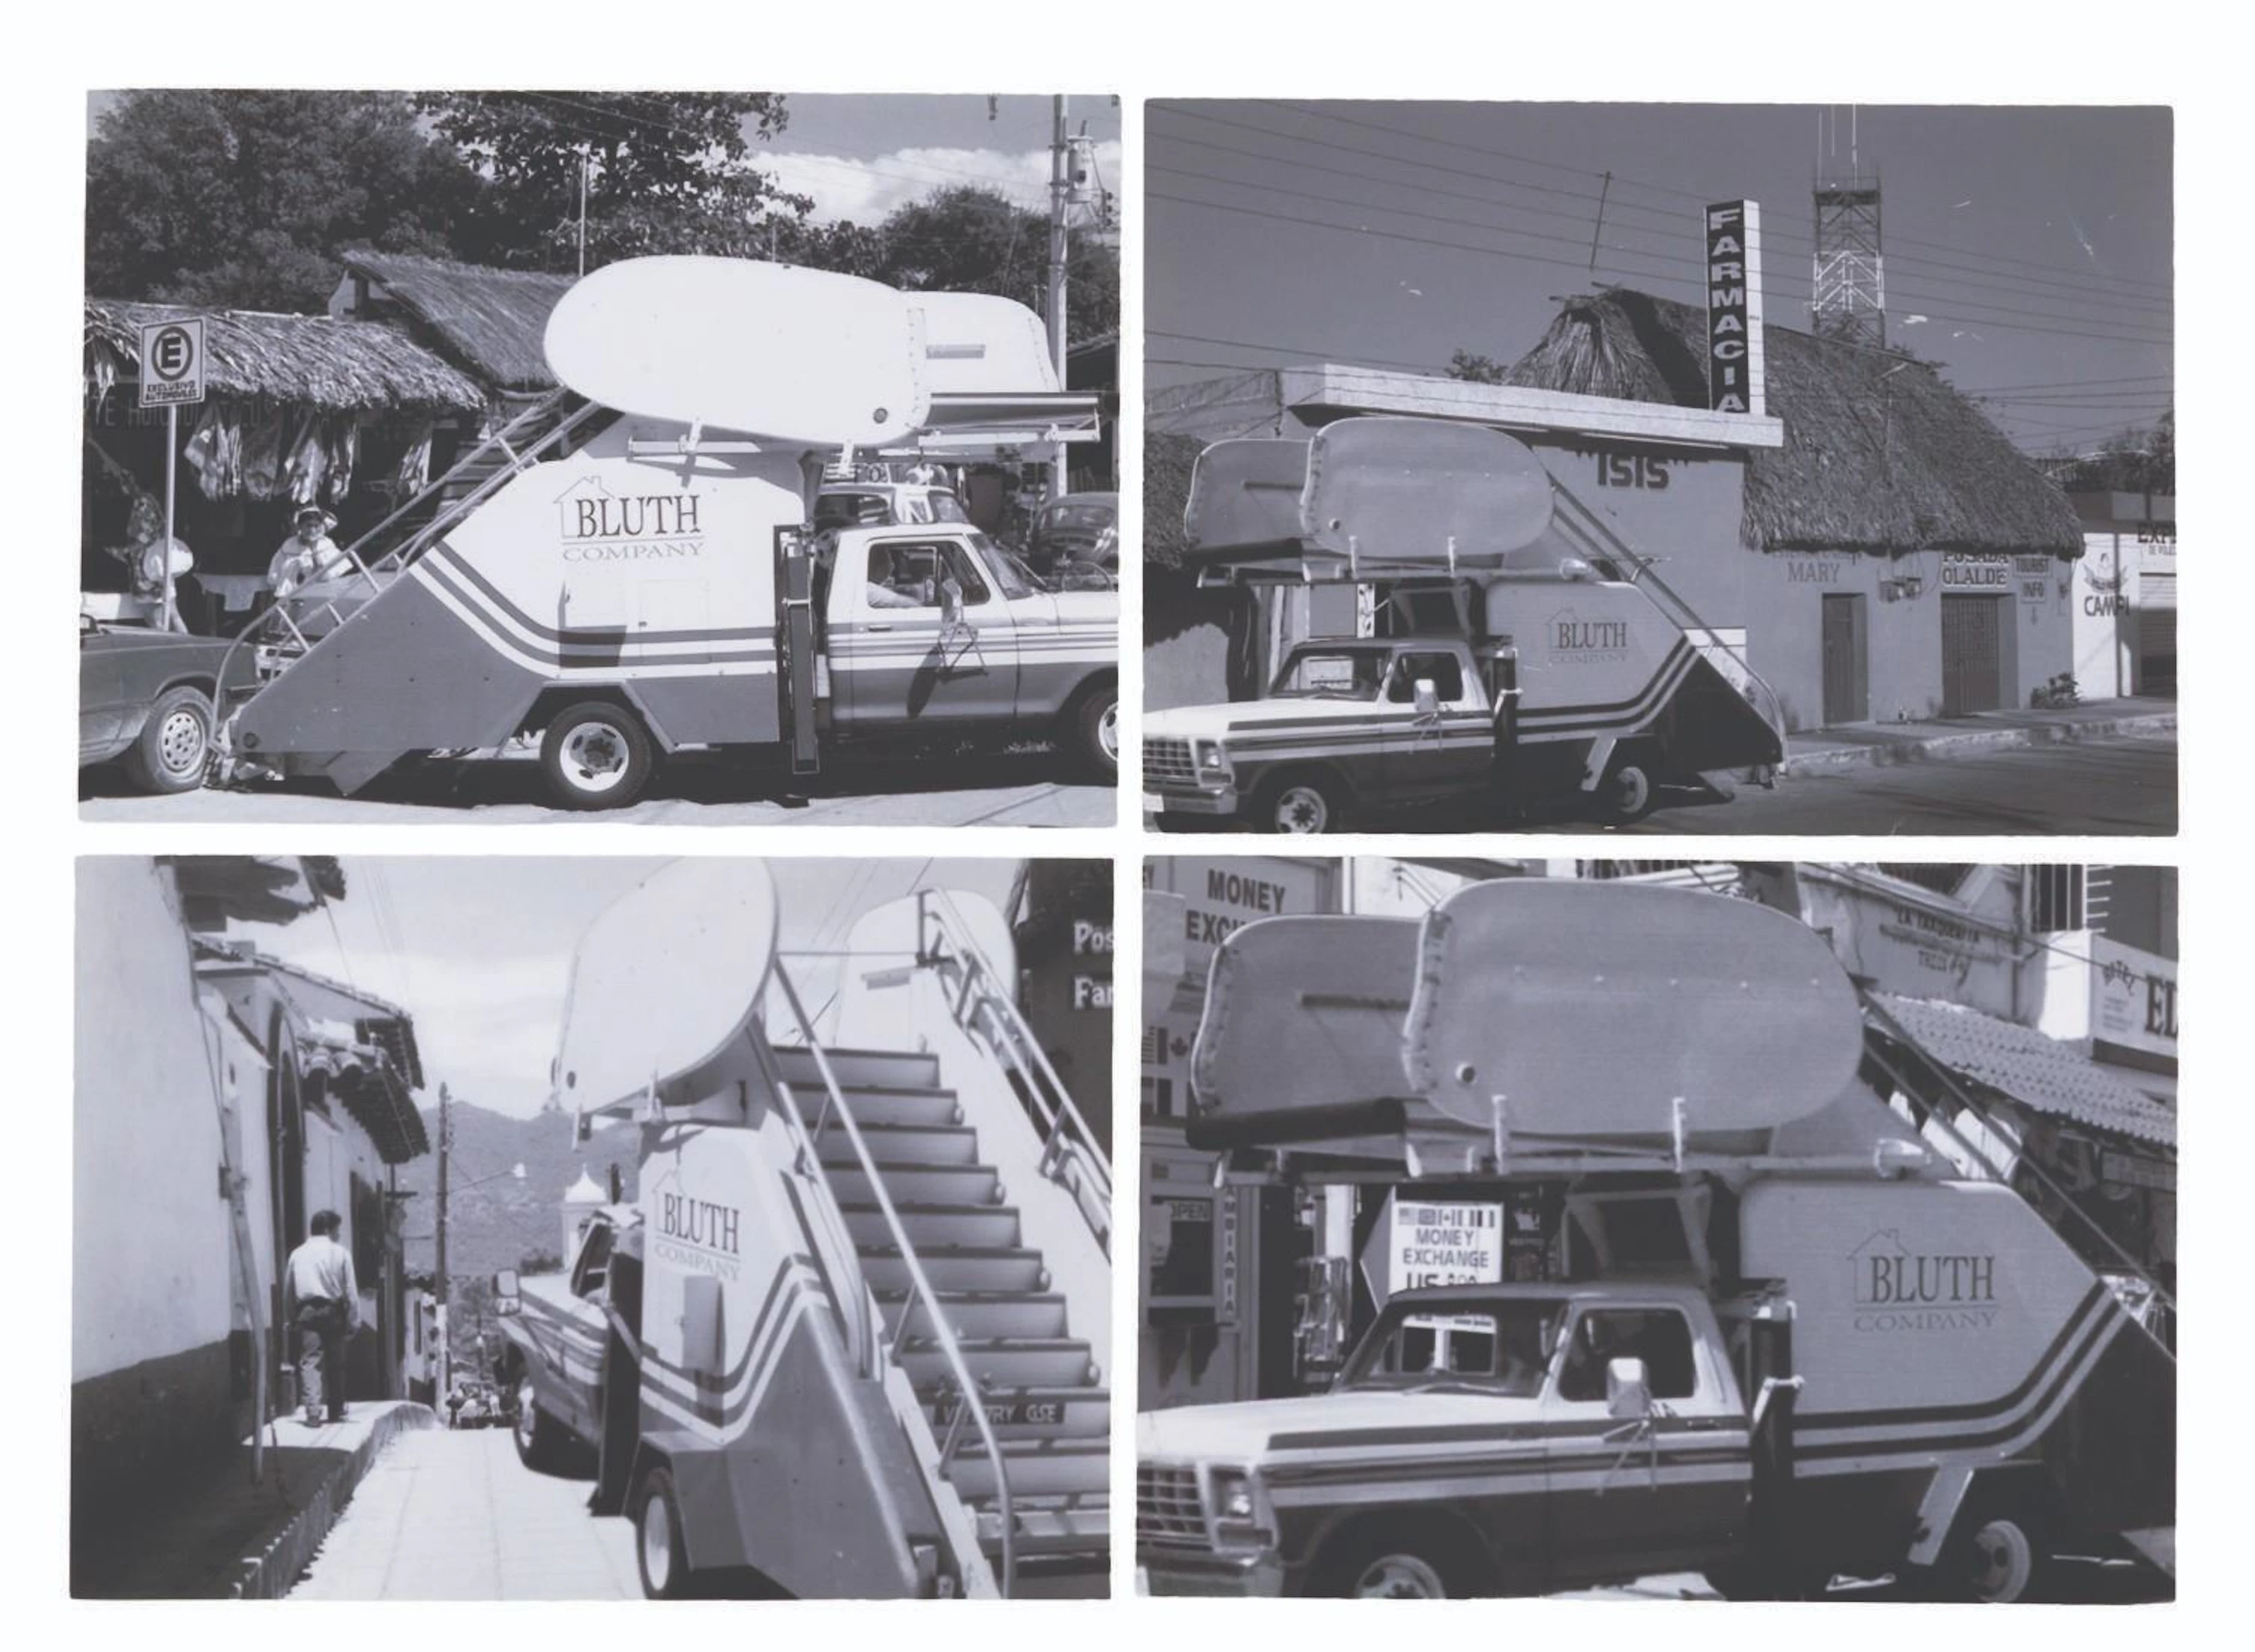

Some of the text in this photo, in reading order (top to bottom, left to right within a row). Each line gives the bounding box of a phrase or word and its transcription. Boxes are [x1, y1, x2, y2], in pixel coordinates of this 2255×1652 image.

[1709, 208, 1745, 413] FARMACIA
[161, 337, 181, 368] E
[576, 494, 701, 539] BLUTH
[563, 542, 704, 562] COMPANY
[1787, 561, 1840, 583] MARY
[1943, 567, 2007, 586] OLALDE
[2022, 581, 2045, 597] INFO
[1557, 622, 1627, 650] BLUTH
[1207, 869, 1286, 915] MONEY
[664, 1192, 739, 1255] BLUTH
[1416, 1227, 1475, 1246] MONEY
[654, 1243, 741, 1283] COMPANY
[1403, 1248, 1490, 1268] EXCHANGE
[1870, 1255, 1995, 1303] BLUTH
[1853, 1311, 1998, 1333] COMPANY
